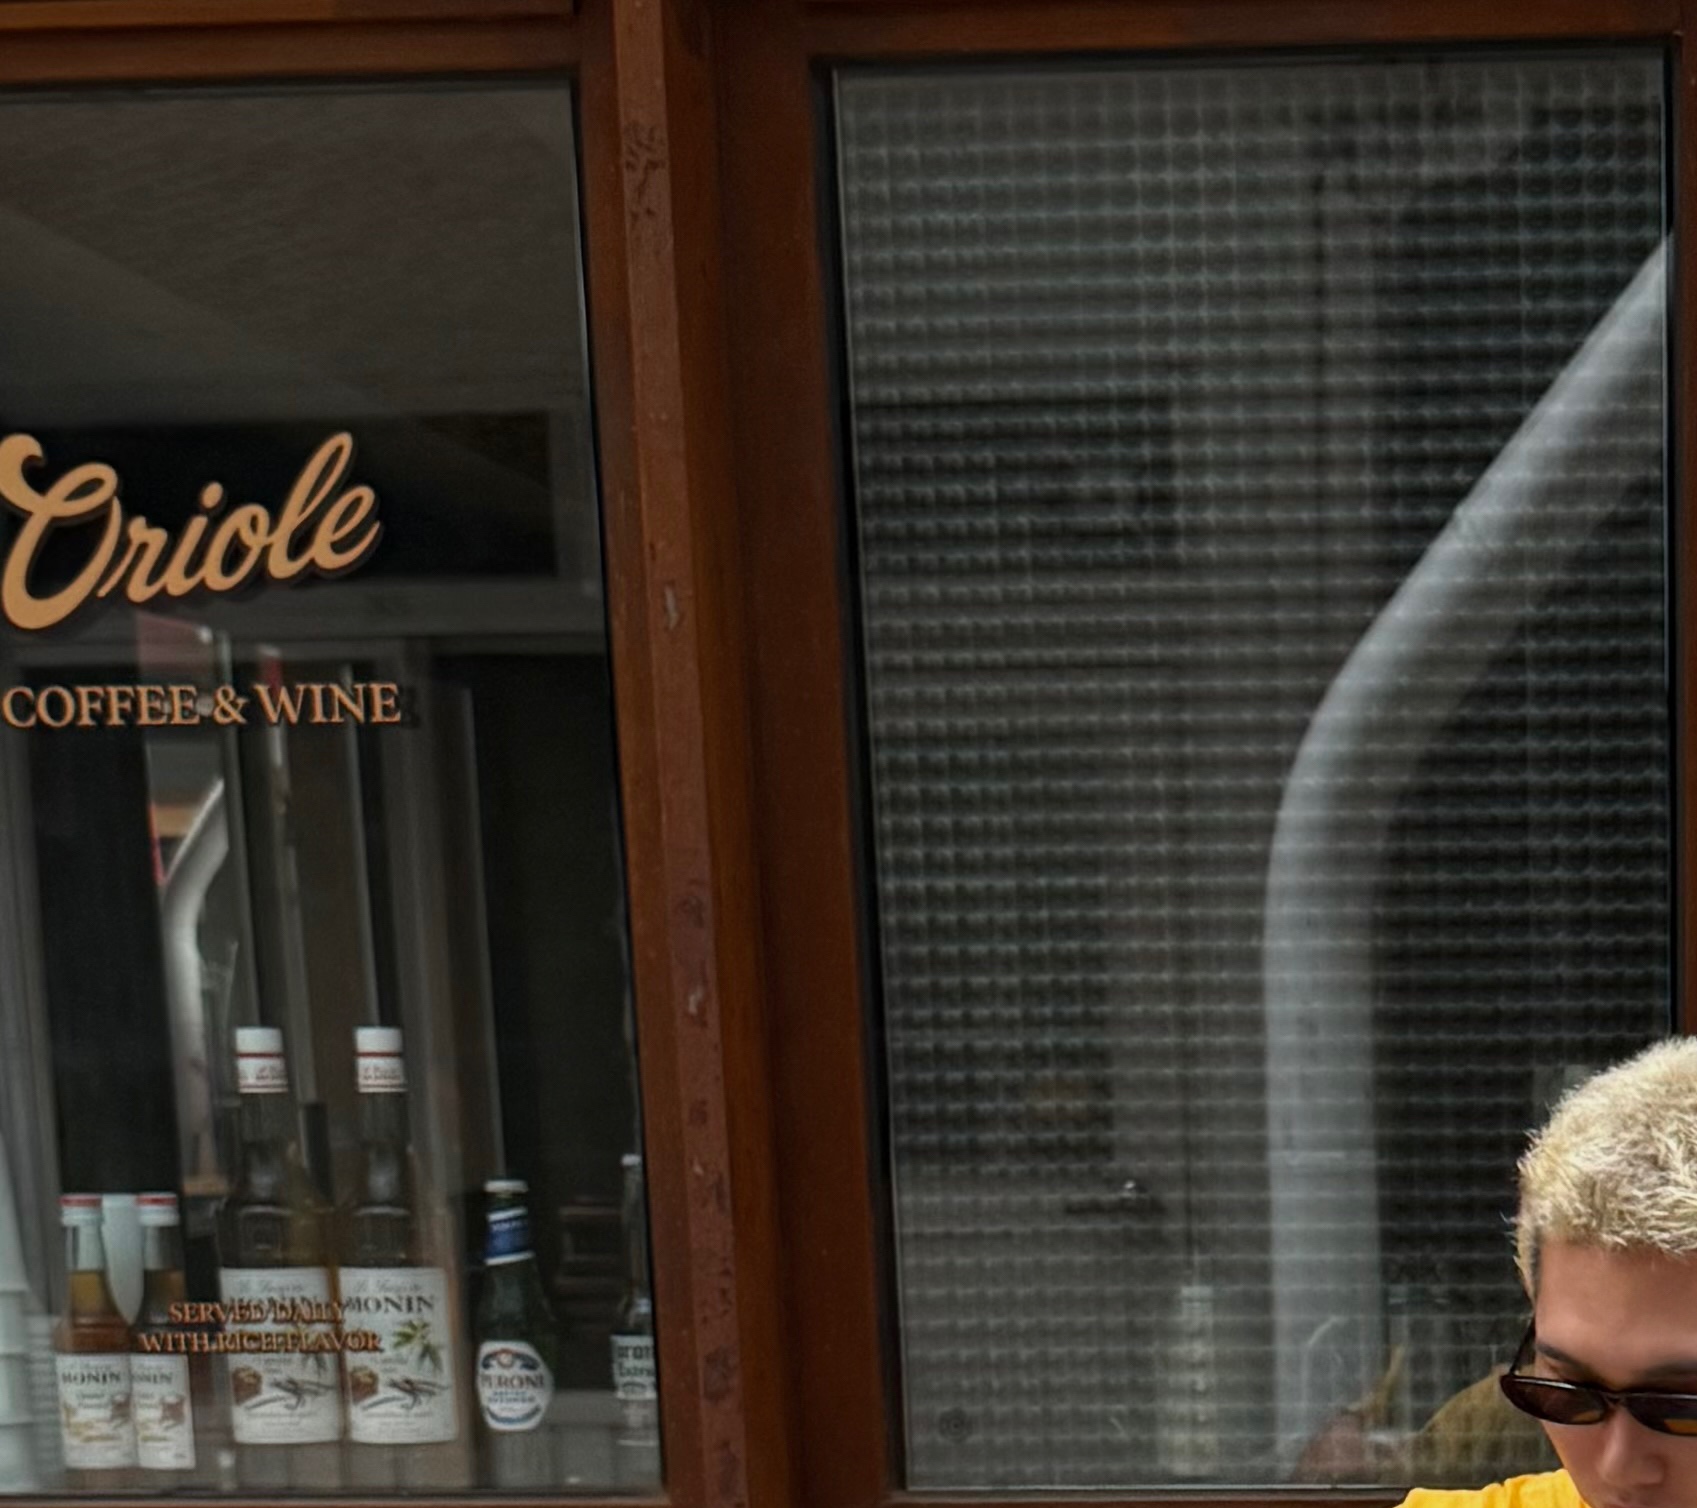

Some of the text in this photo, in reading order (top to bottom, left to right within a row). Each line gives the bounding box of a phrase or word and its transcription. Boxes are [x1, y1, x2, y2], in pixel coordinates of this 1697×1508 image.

[0, 432, 381, 630] Oriole
[3, 682, 402, 728] COFFEE & WINE
[168, 1300, 346, 1324] SERVED DAILY
[138, 1331, 209, 1352] WITH
[286, 1331, 383, 1352] FLAVOR
